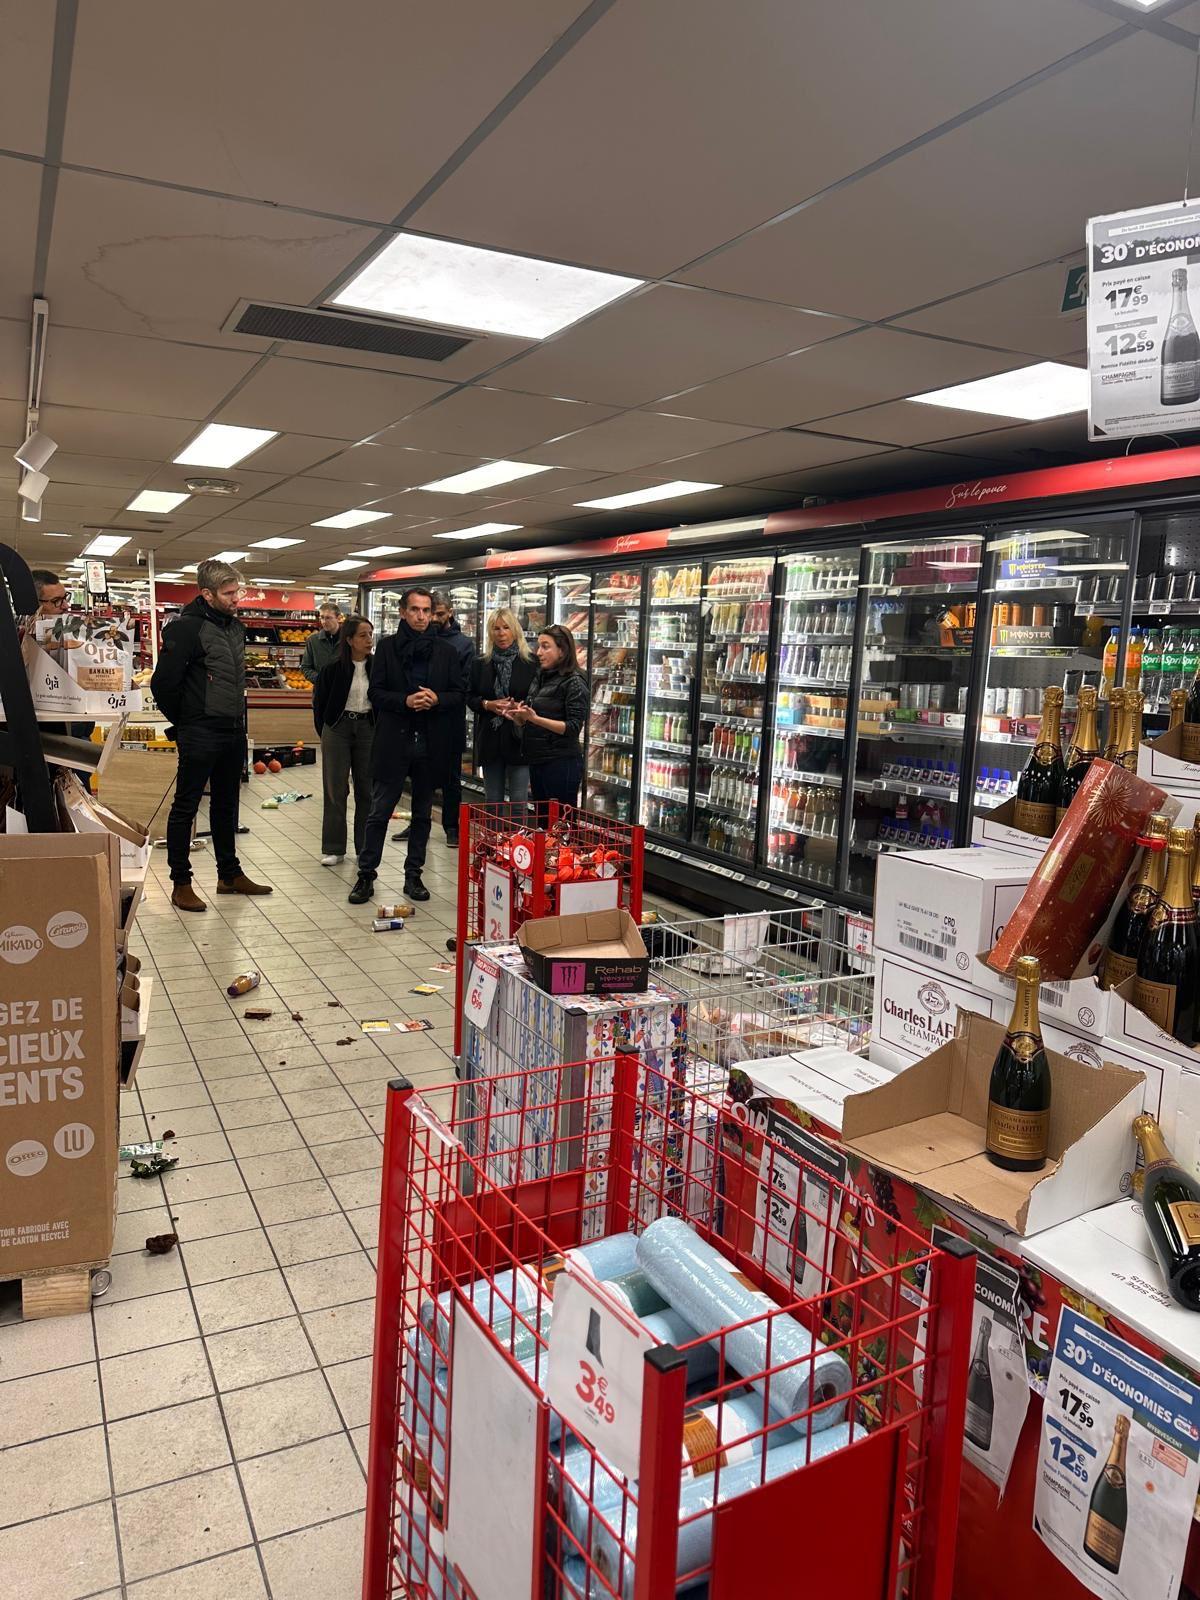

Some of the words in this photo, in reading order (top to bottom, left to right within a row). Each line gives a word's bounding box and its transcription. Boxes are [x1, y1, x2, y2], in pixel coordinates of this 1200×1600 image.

[1100, 241, 1134, 263] 30%
[1113, 279, 1126, 287] payé
[1134, 274, 1151, 282] caisse
[1101, 371, 1136, 381] CHAMPAGNE
[1010, 630, 1051, 639] MONSTER
[50, 922, 87, 938] Granola
[595, 964, 642, 975] Rehab
[52, 997, 83, 1022] DE
[884, 998, 926, 1028] Charles
[64, 1129, 85, 1152] LU
[10, 1151, 44, 1164] OREO
[18, 1222, 50, 1234] FABRIQUÉ
[52, 1221, 69, 1230] AVEC
[1, 1238, 10, 1247] DE
[12, 1234, 39, 1246] CARTON
[41, 1230, 70, 1242] RECYCLÉ
[1111, 1272, 1126, 1281] UP
[1125, 1280, 1149, 1295] SIDE
[1149, 1294, 1171, 1308] THIS
[1058, 1372, 1068, 1383] Prix
[1067, 1379, 1078, 1391] payé
[1085, 1391, 1100, 1405] caisse
[1063, 1338, 1093, 1365] 30%
[1092, 1362, 1172, 1424] D'ÉCONOMIES
